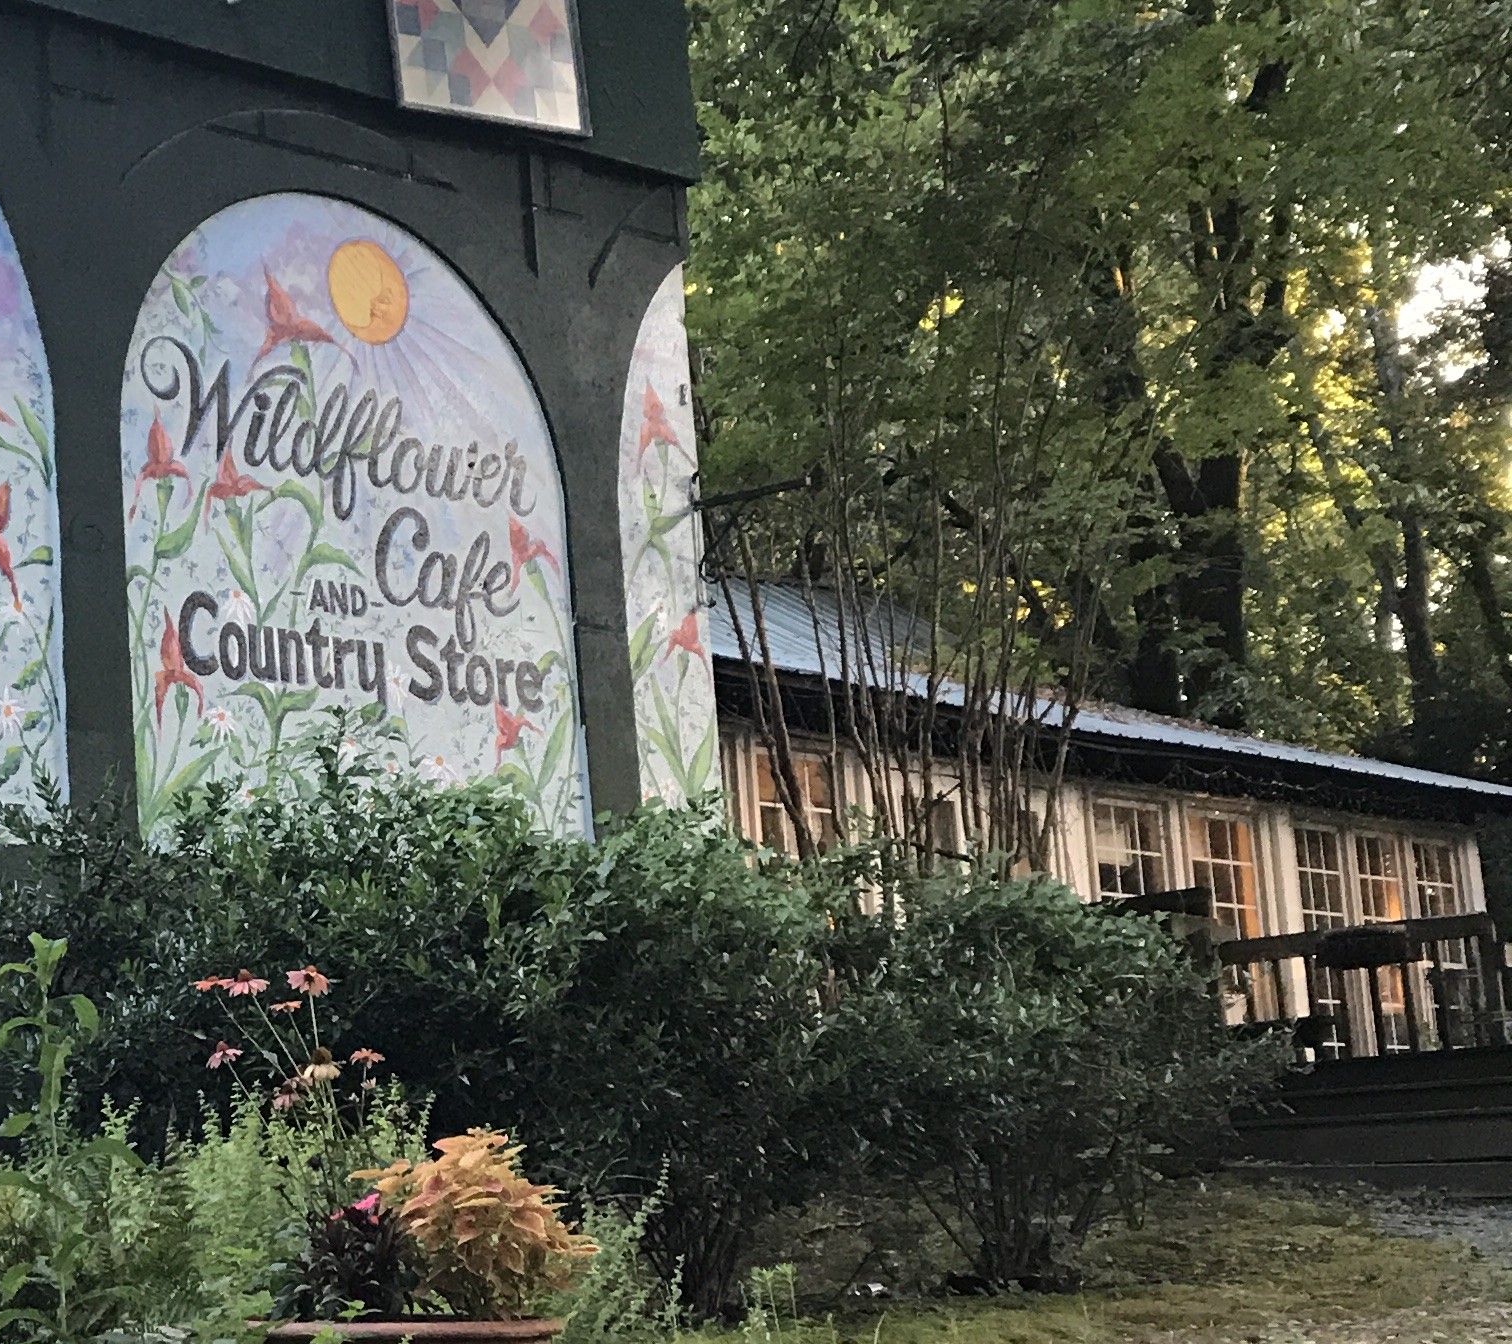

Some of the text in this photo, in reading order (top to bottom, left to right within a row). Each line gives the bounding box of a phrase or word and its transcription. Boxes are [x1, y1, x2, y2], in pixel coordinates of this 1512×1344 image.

[142, 337, 537, 520] Wildflower
[376, 507, 519, 650] Cafe
[179, 591, 544, 722] Country Store
